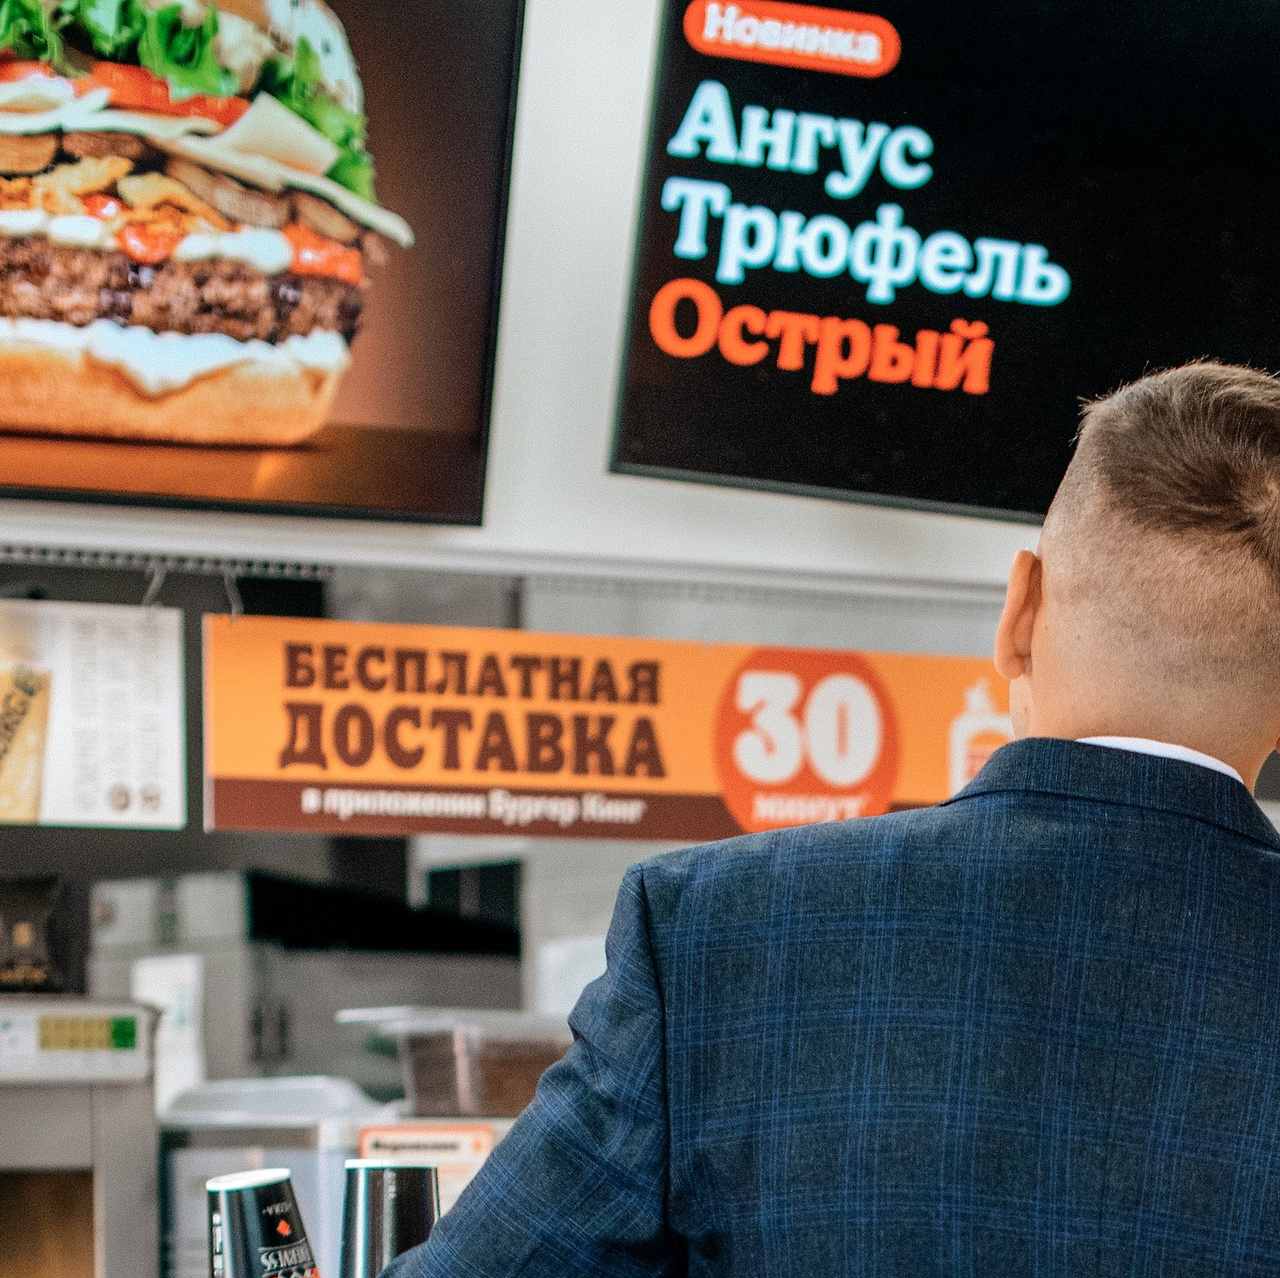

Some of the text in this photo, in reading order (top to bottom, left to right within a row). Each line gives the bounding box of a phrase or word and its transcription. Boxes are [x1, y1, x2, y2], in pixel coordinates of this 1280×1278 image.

[703, 3, 882, 63] Новинка
[667, 80, 934, 199] Ангус
[661, 177, 1072, 307] Трюфель
[649, 278, 994, 395] Острый
[283, 642, 661, 704] БЕСПЛАТНАЯ
[733, 669, 884, 787] 30
[278, 702, 667, 778] ДОСТАВКА
